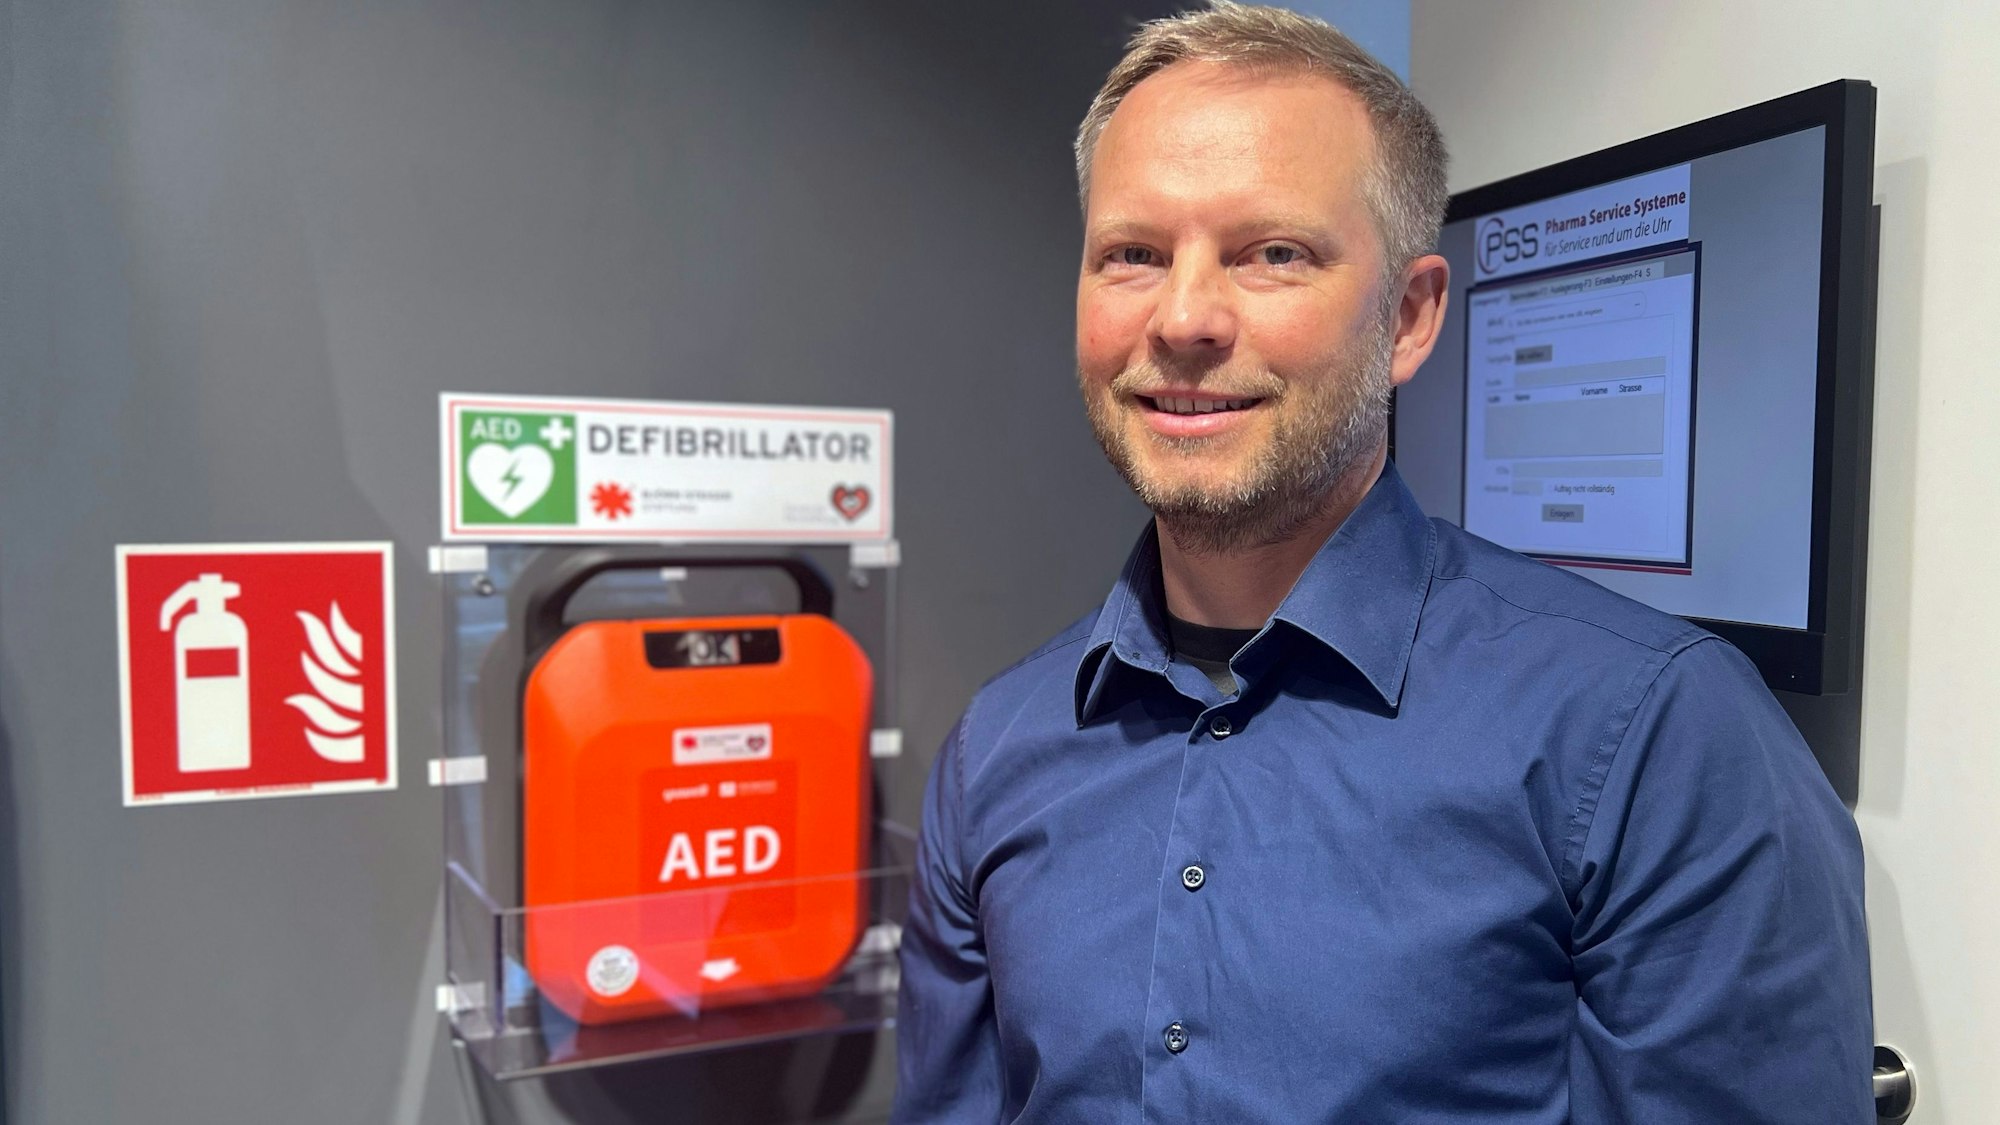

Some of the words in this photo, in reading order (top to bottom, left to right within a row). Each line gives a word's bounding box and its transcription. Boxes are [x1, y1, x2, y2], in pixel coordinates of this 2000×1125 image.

[1545, 214, 1586, 236] Pharma
[1589, 202, 1631, 226] Service
[1633, 190, 1686, 218] Systeme
[1544, 242, 1557, 258] für
[1558, 238, 1590, 255] Service
[1591, 231, 1614, 249] rund
[1616, 229, 1633, 242] um
[1634, 223, 1650, 238] die
[1652, 217, 1672, 235] Uhr
[1580, 386, 1608, 396] Vorname
[1618, 383, 1642, 393] Strasse
[470, 418, 522, 440] AED
[587, 424, 870, 462] DEFIBRILLATOR
[659, 826, 782, 882] AED
